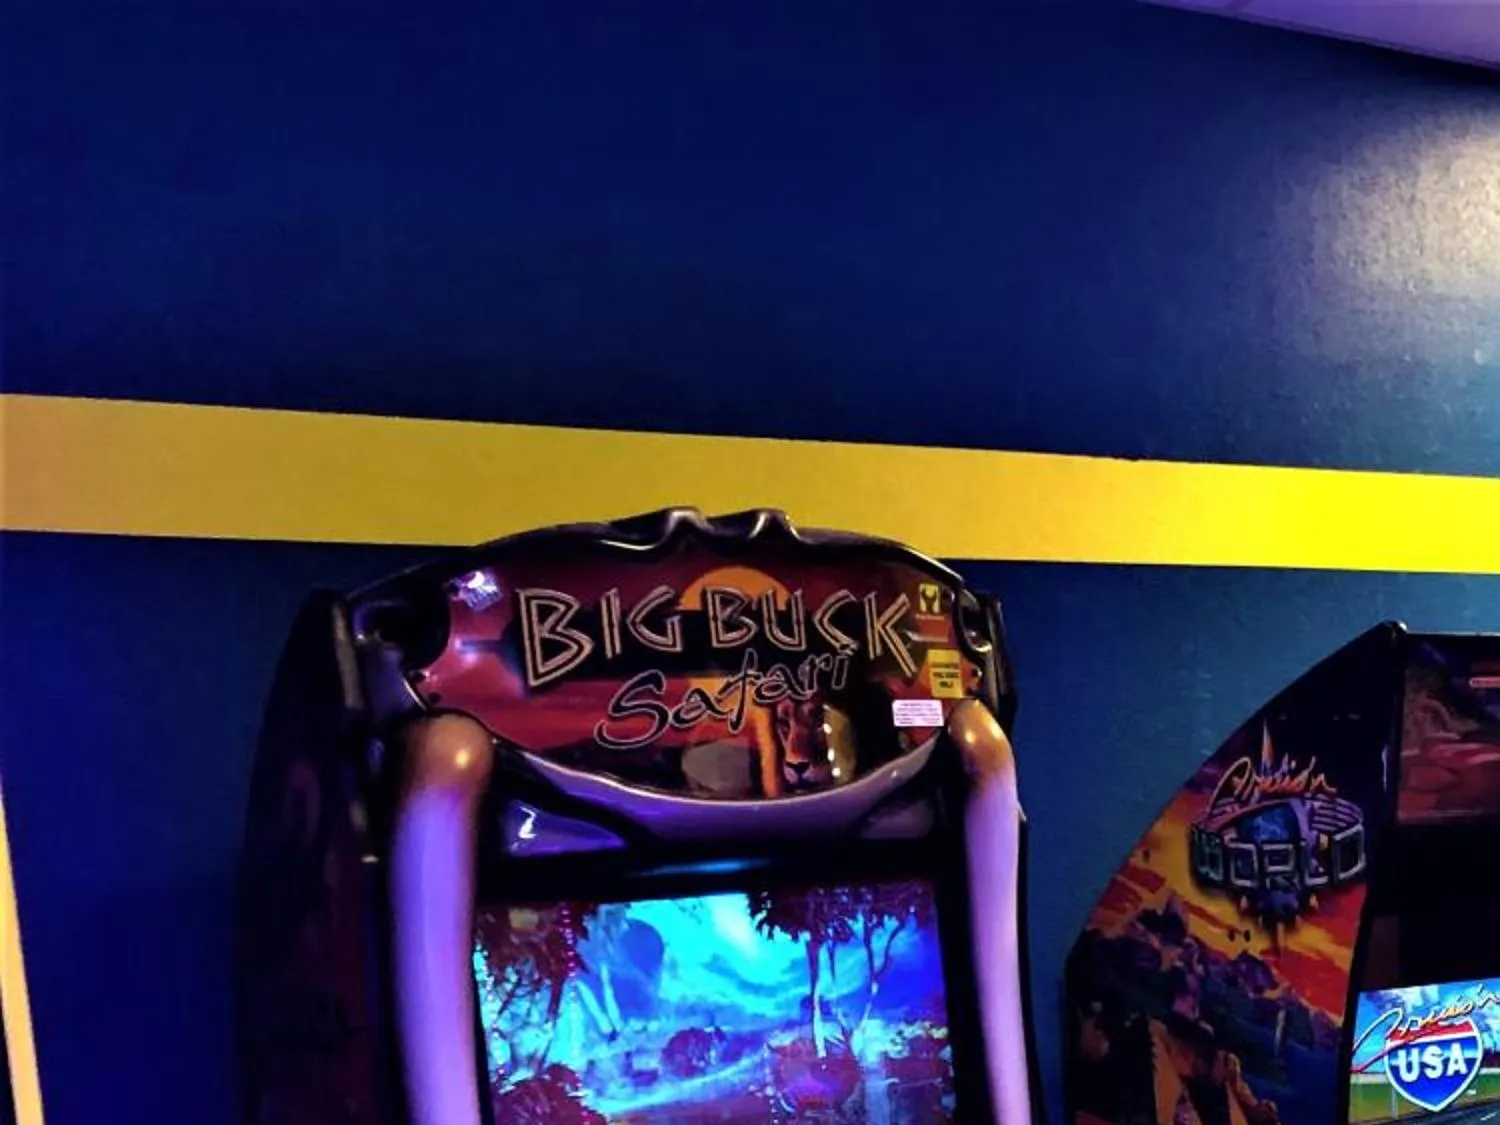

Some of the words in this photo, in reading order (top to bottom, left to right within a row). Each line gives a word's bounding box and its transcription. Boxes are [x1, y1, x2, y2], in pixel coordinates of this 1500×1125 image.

[516, 584, 684, 689] BIG
[703, 586, 919, 679] BUCK
[593, 644, 853, 749] Safari
[1192, 822, 1367, 890] WORLD
[1391, 1042, 1468, 1083] USA
